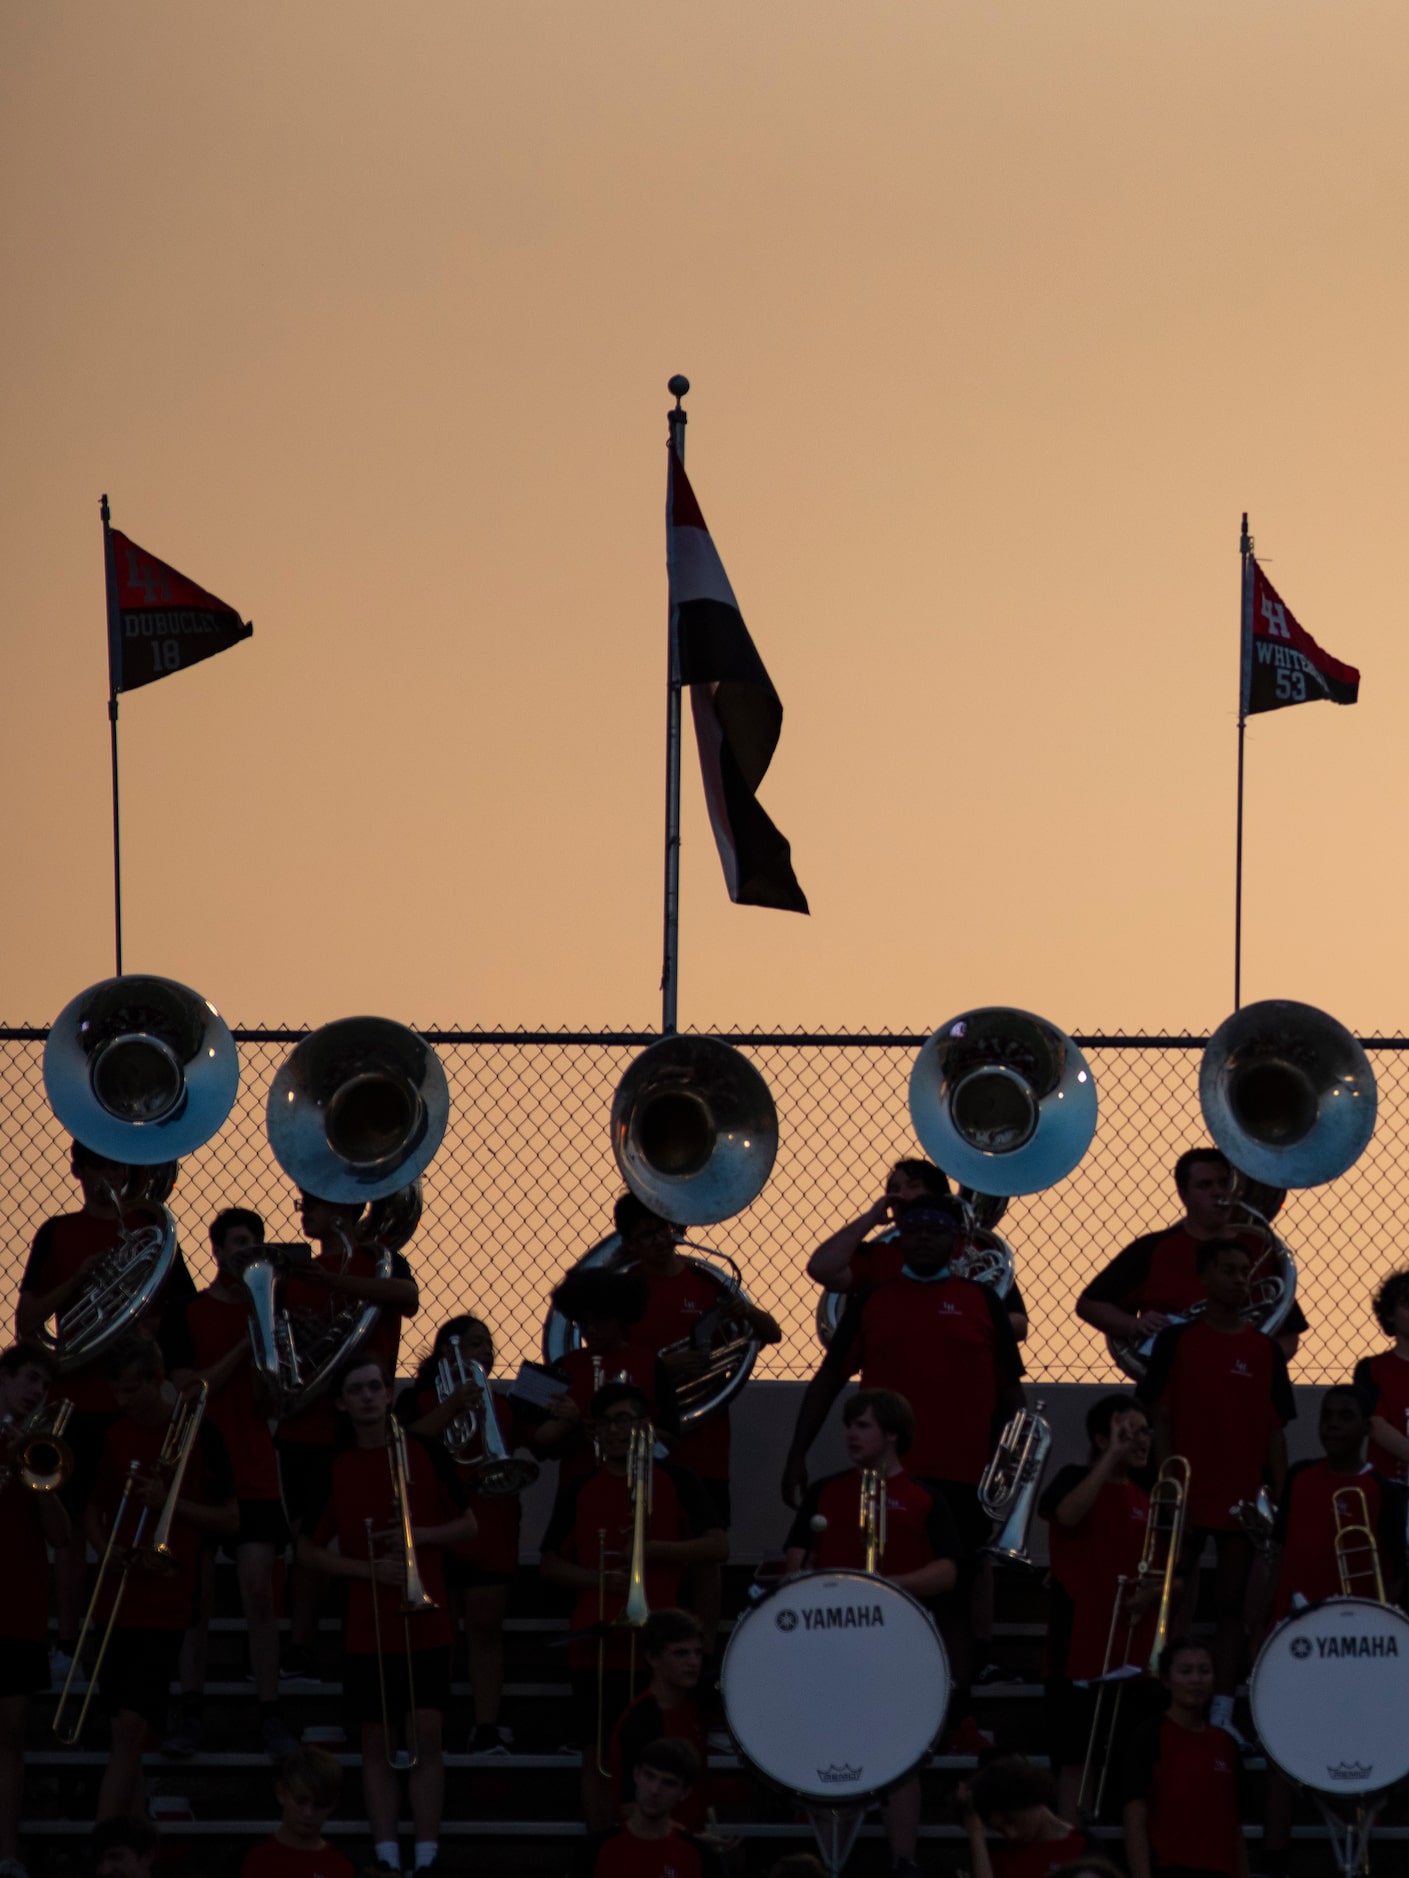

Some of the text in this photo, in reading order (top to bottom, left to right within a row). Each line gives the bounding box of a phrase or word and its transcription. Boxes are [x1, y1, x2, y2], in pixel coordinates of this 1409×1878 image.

[151, 638, 181, 673] 18
[1275, 668, 1307, 702] 53
[801, 1605, 884, 1631] YAMAHA
[1316, 1635, 1399, 1659] YAMAHA
